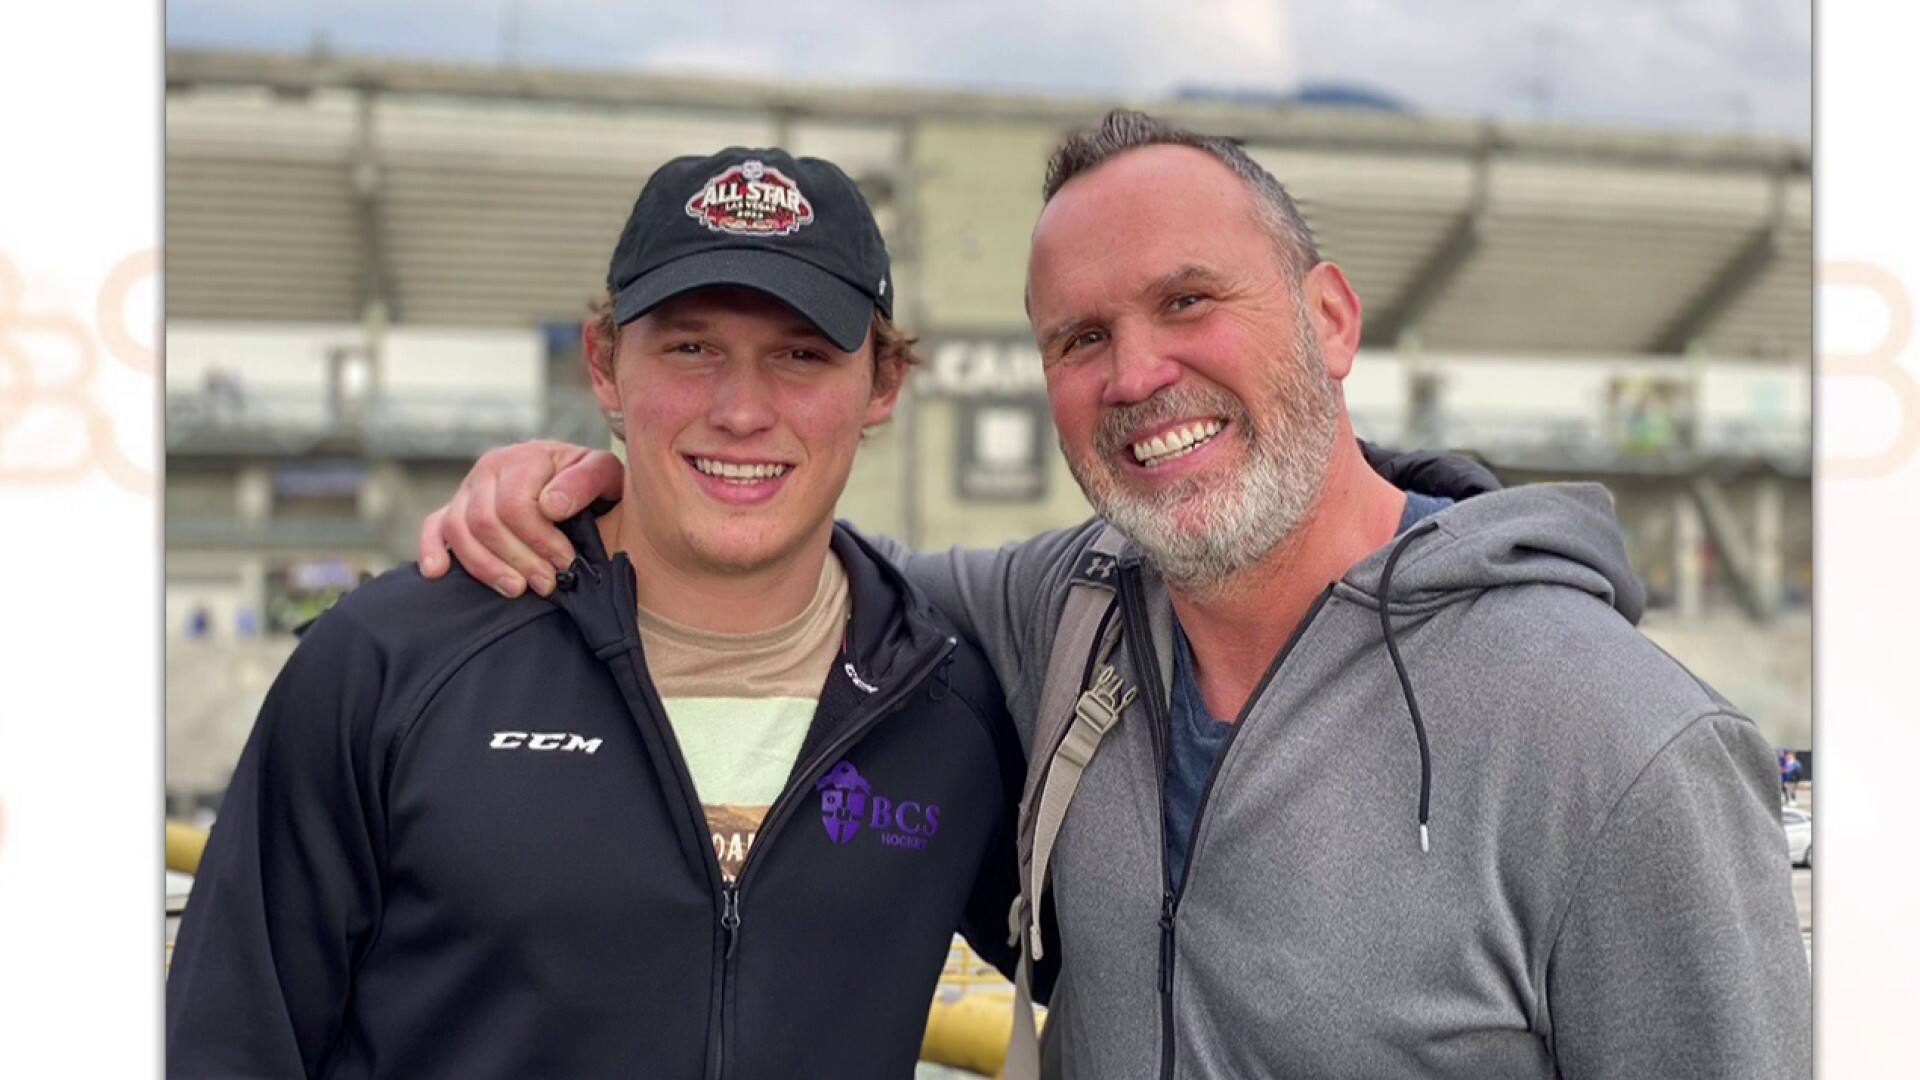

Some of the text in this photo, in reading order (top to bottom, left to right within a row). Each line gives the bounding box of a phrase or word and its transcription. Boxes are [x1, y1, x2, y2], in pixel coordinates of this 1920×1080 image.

[703, 181, 801, 216] ALL STAR
[489, 731, 604, 755] CCM
[870, 795, 941, 838] BCS
